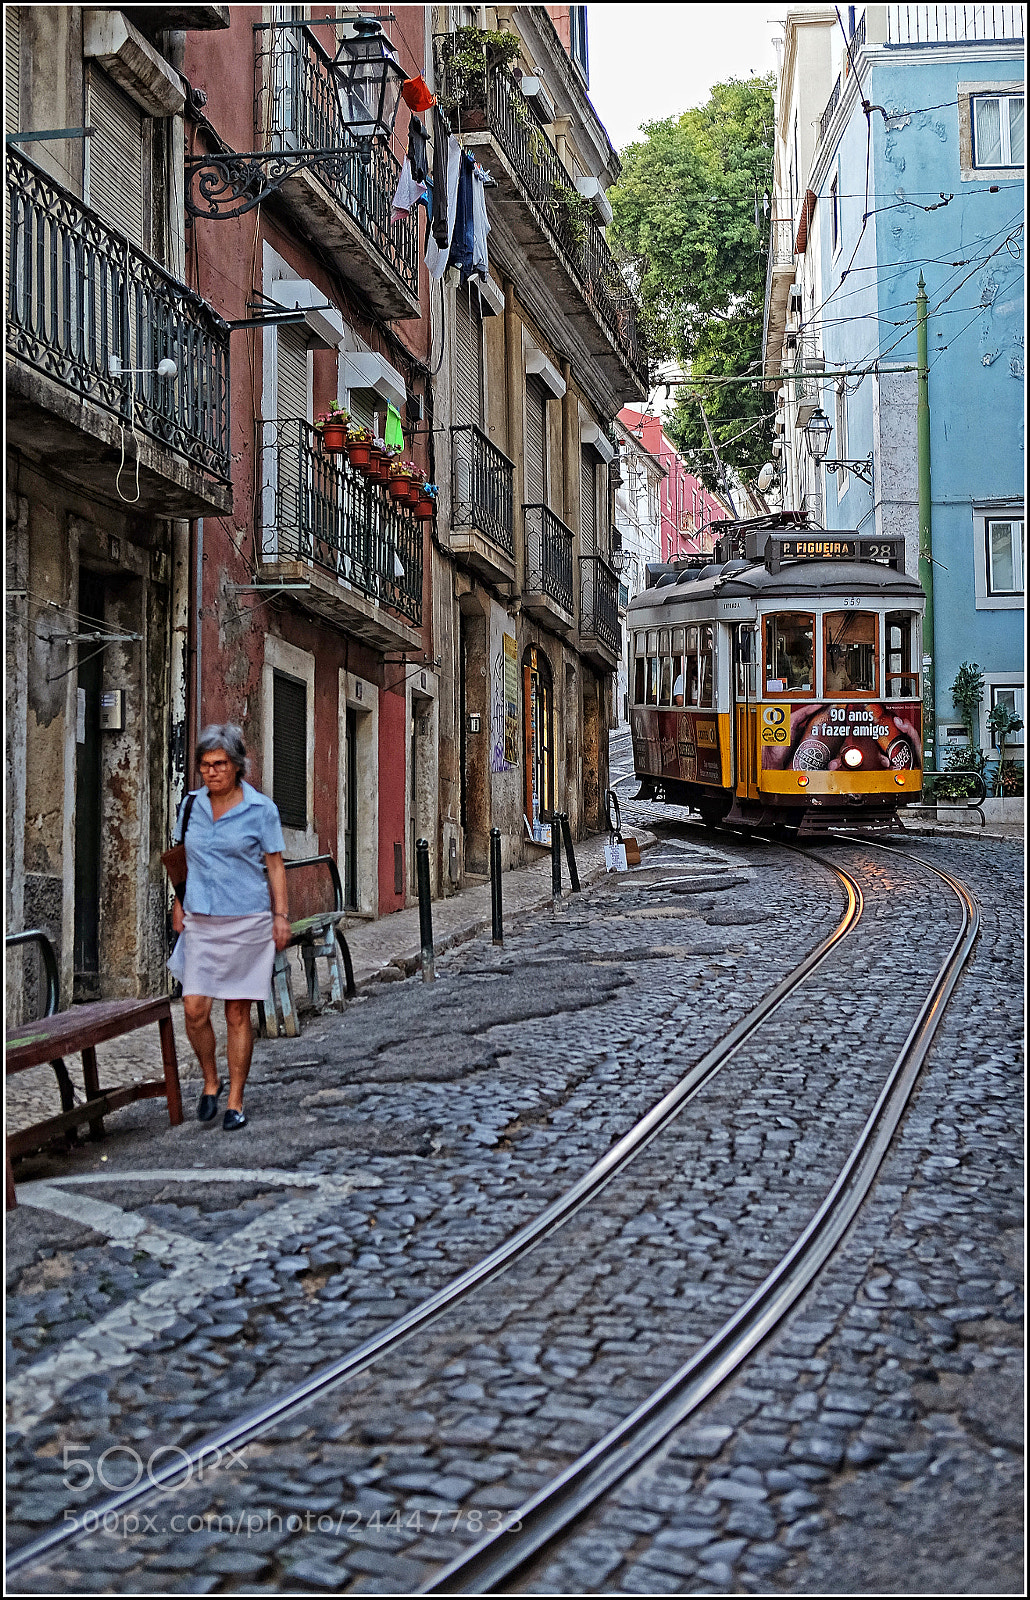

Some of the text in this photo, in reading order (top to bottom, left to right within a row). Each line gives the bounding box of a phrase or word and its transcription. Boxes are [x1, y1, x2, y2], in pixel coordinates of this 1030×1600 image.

[783, 542, 849, 554] P. FIGUEIRA
[869, 545, 891, 558] 28
[843, 598, 861, 606] 559
[830, 708, 874, 722] 90 anos
[811, 724, 890, 740] a fazer amigos
